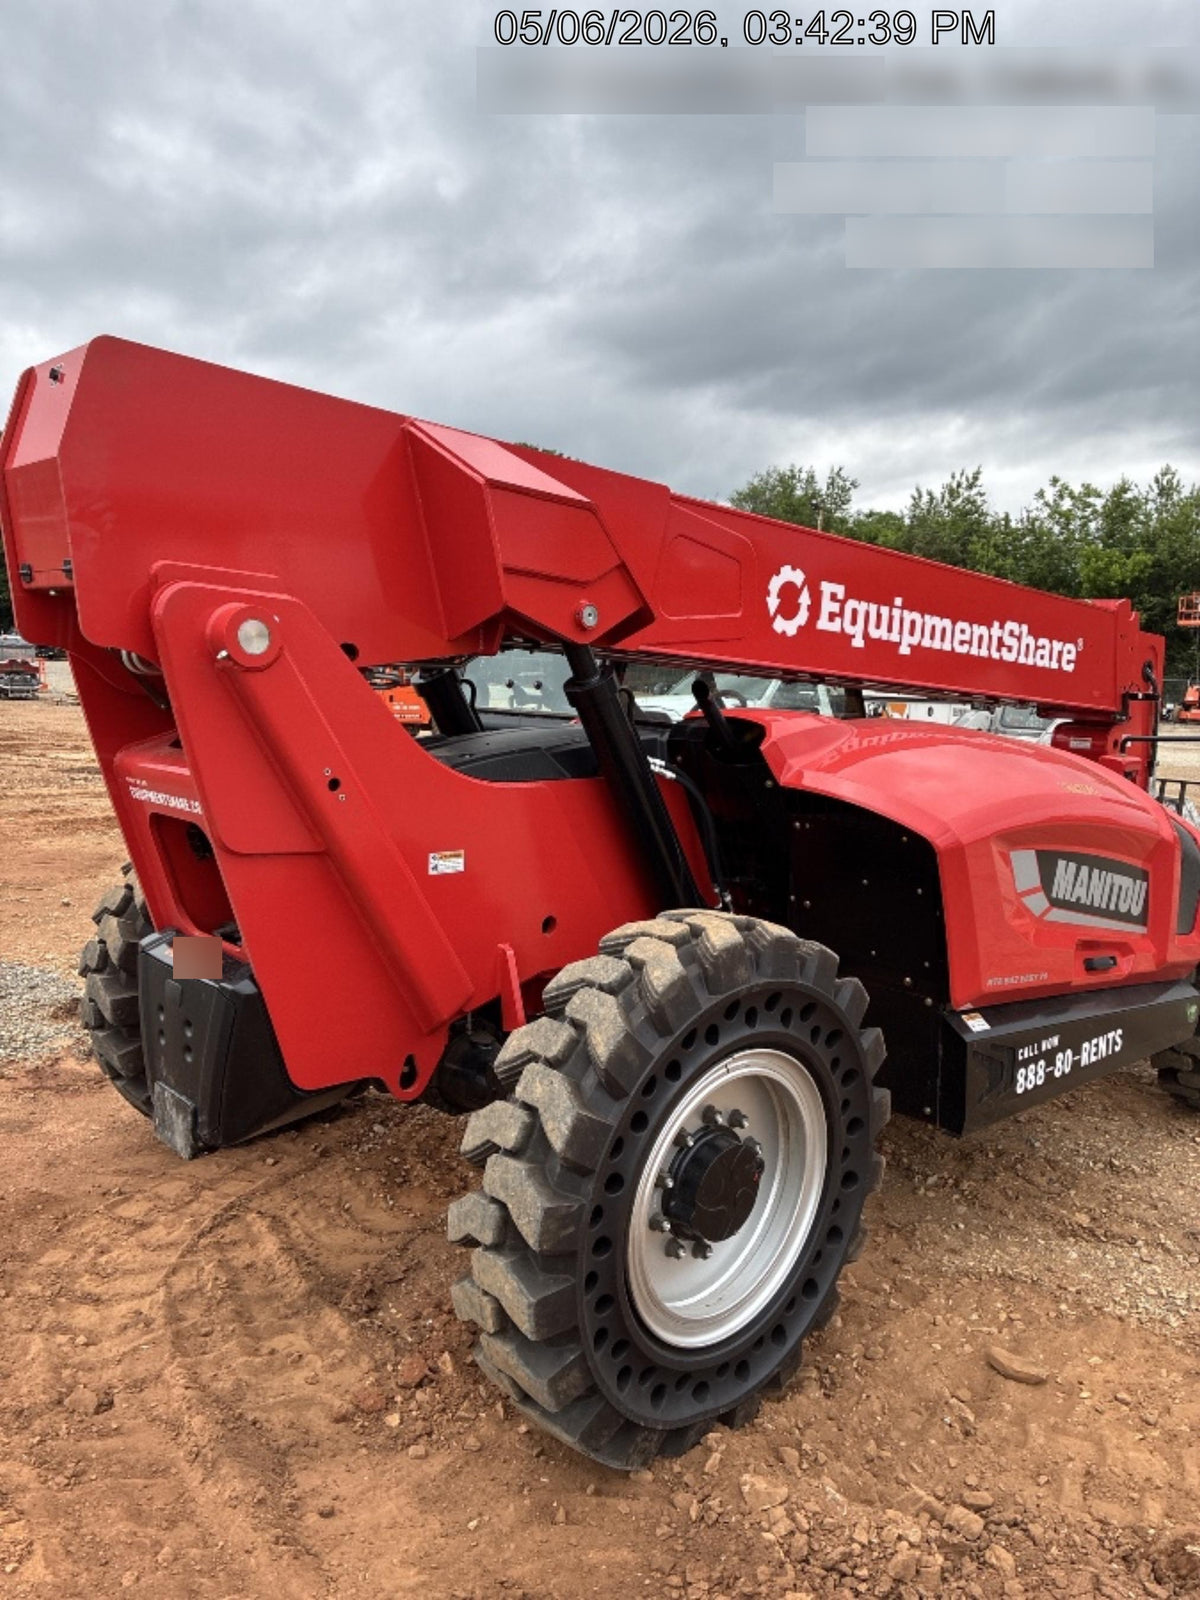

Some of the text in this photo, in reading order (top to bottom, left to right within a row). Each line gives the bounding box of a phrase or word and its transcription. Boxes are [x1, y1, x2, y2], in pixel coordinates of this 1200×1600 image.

[1051, 858, 1148, 917] MANITOU
[1015, 1028, 1124, 1095] 888-80-RENTS
[1018, 1034, 1061, 1061] CALL NOW
